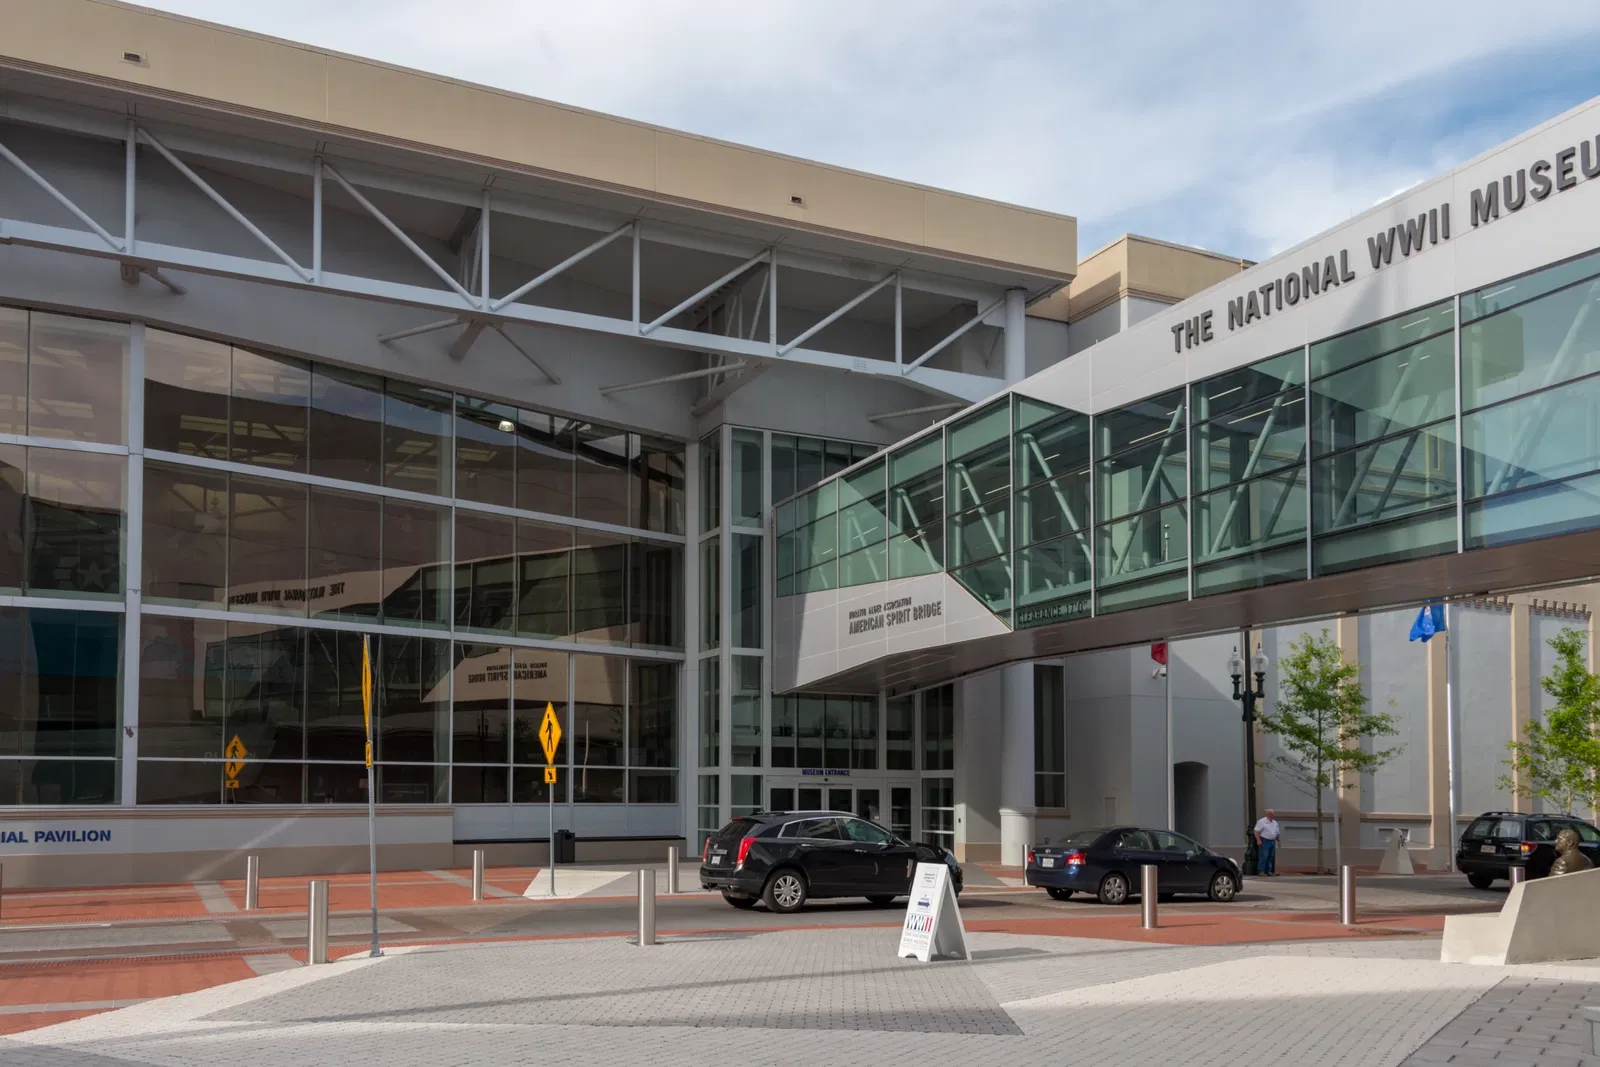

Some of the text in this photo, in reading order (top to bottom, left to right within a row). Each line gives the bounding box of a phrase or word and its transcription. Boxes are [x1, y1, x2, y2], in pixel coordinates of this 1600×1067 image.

[1171, 134, 1600, 353] THE NATIONAL WWII MUSEU
[849, 600, 942, 636] AMERICAN SPIRIT BRIDGE
[1019, 605, 1062, 625] CLEARANCE
[0, 830, 112, 843] IAL PAVILION
